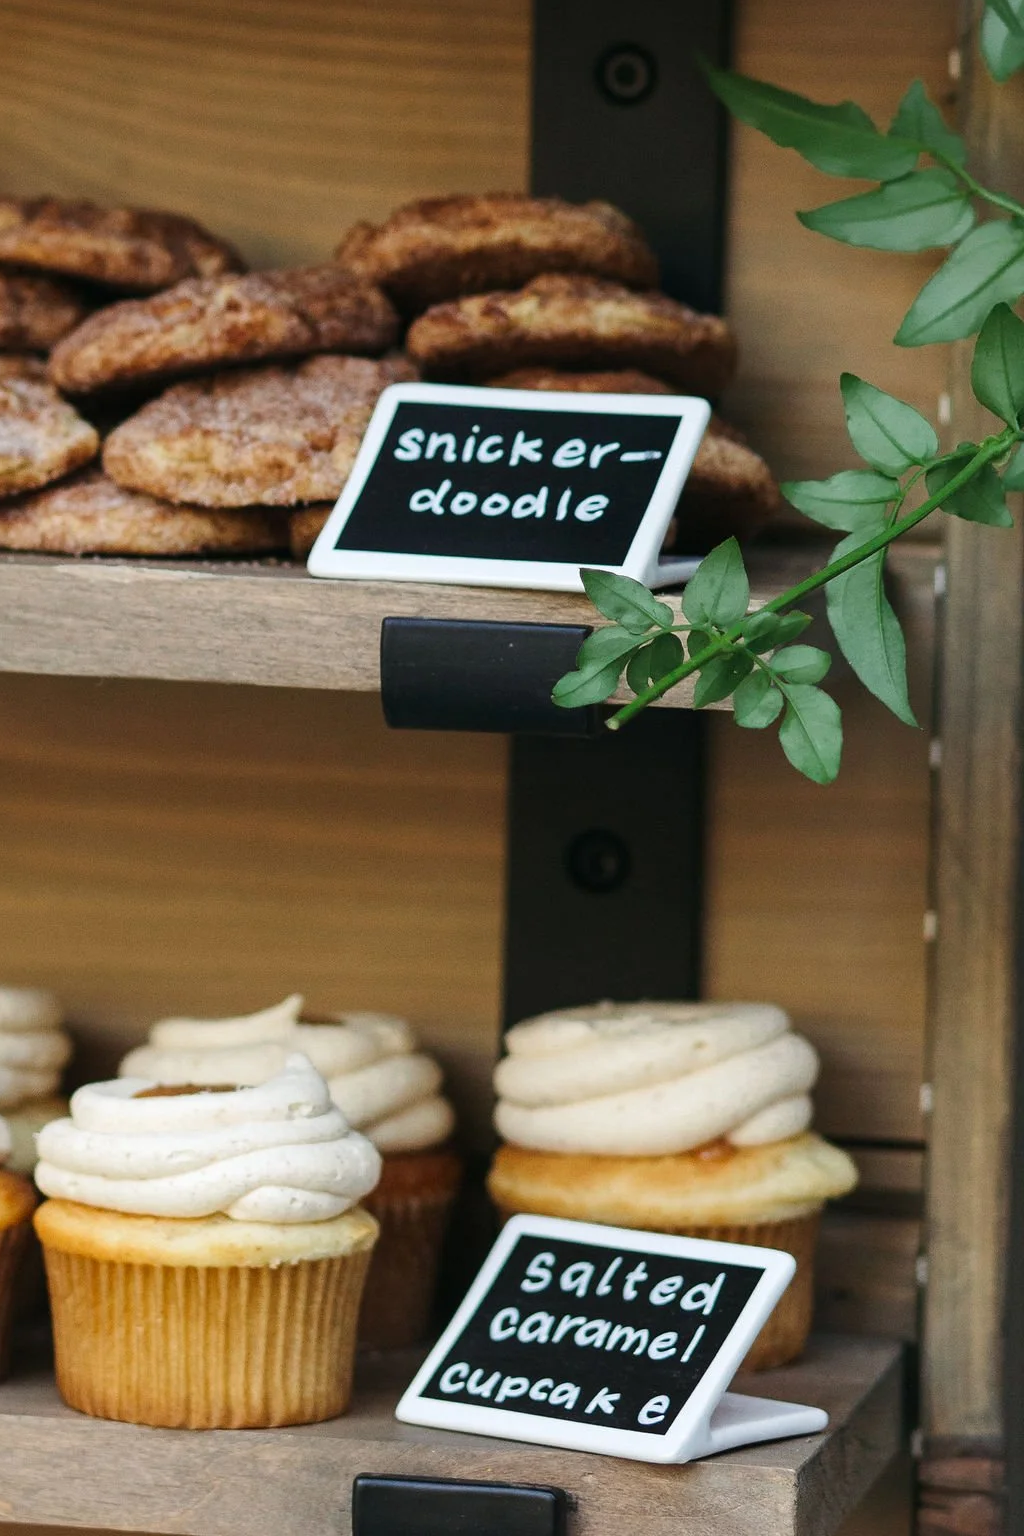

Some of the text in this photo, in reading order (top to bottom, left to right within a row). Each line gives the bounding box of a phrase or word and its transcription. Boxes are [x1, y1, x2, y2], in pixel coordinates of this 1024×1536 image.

[393, 425, 662, 469] snicker-
[408, 479, 610, 523] doodle
[488, 1306, 706, 1363] caramel
[438, 1361, 671, 1426] cupcake
